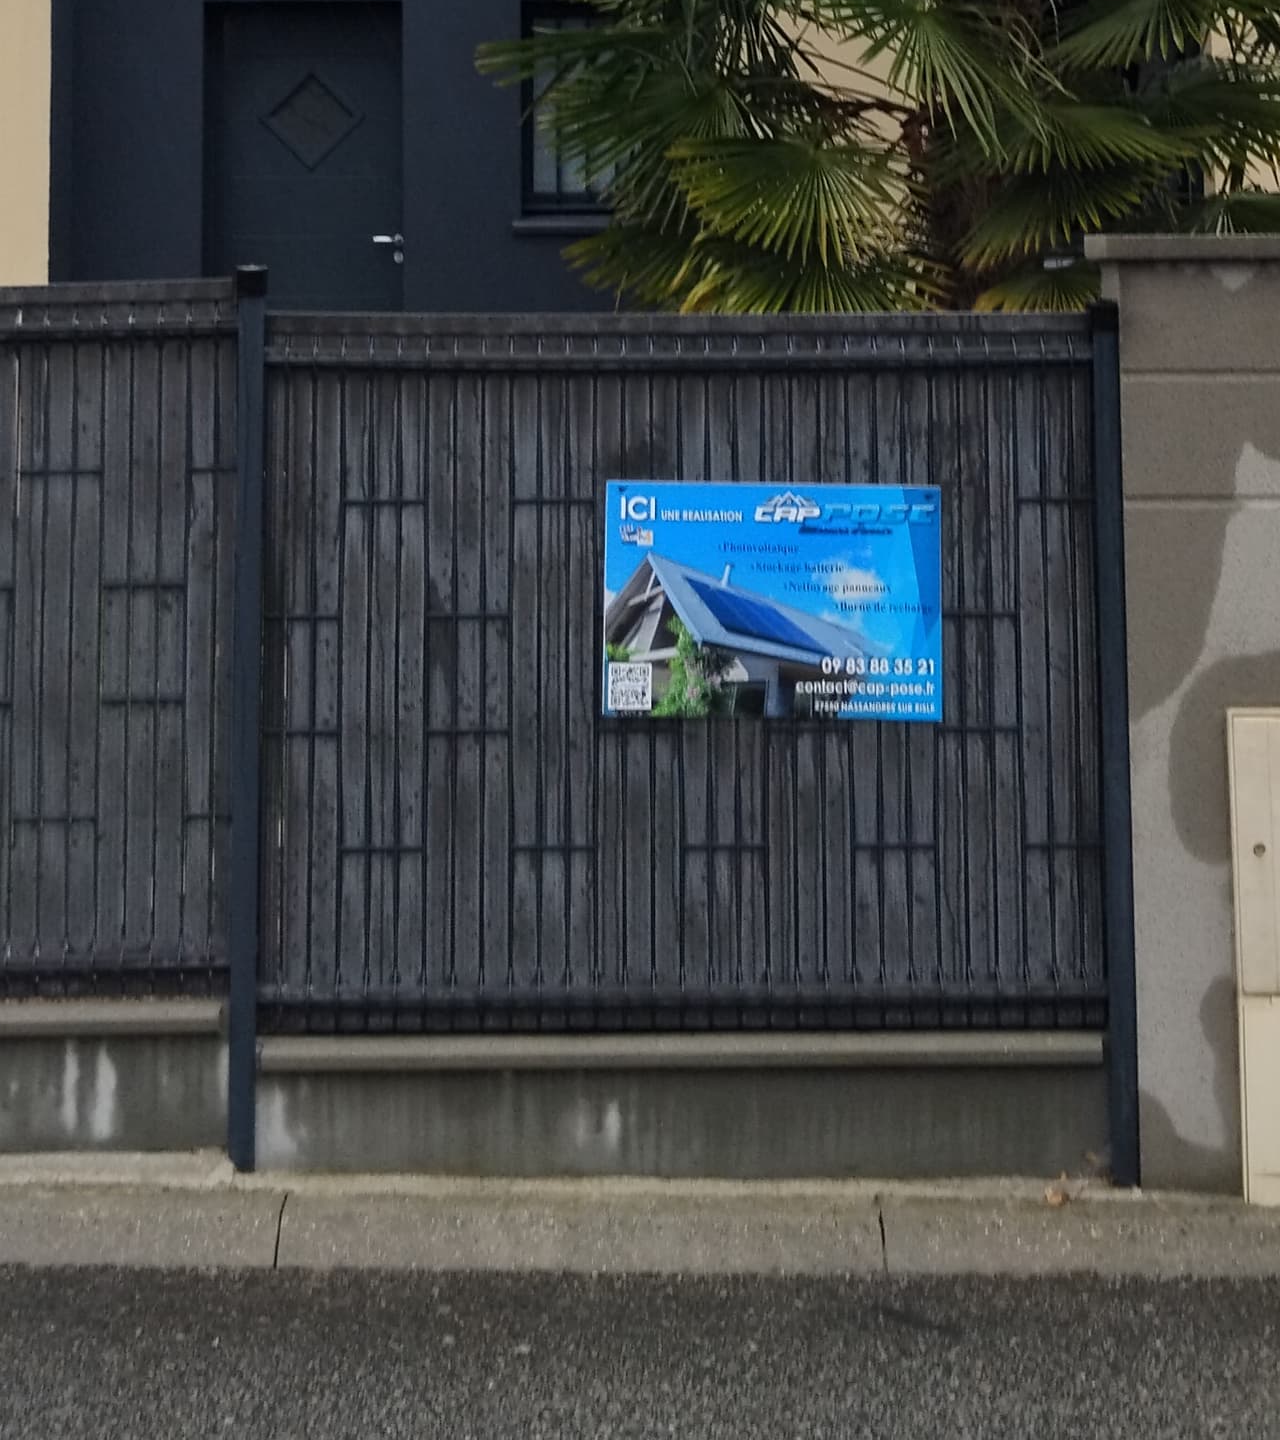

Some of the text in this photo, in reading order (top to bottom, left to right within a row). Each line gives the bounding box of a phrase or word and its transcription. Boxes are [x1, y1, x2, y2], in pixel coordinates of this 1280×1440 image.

[620, 495, 656, 521] ICI
[661, 509, 680, 522] UNE
[754, 503, 935, 525] CAP POSE
[804, 562, 845, 574] batterie
[842, 583, 892, 596] panneaux
[821, 656, 841, 675] 09
[845, 656, 865, 676] 83
[870, 656, 889, 676] 88
[917, 657, 935, 677] 21
[795, 678, 935, 698] contact@cap-pose.fr
